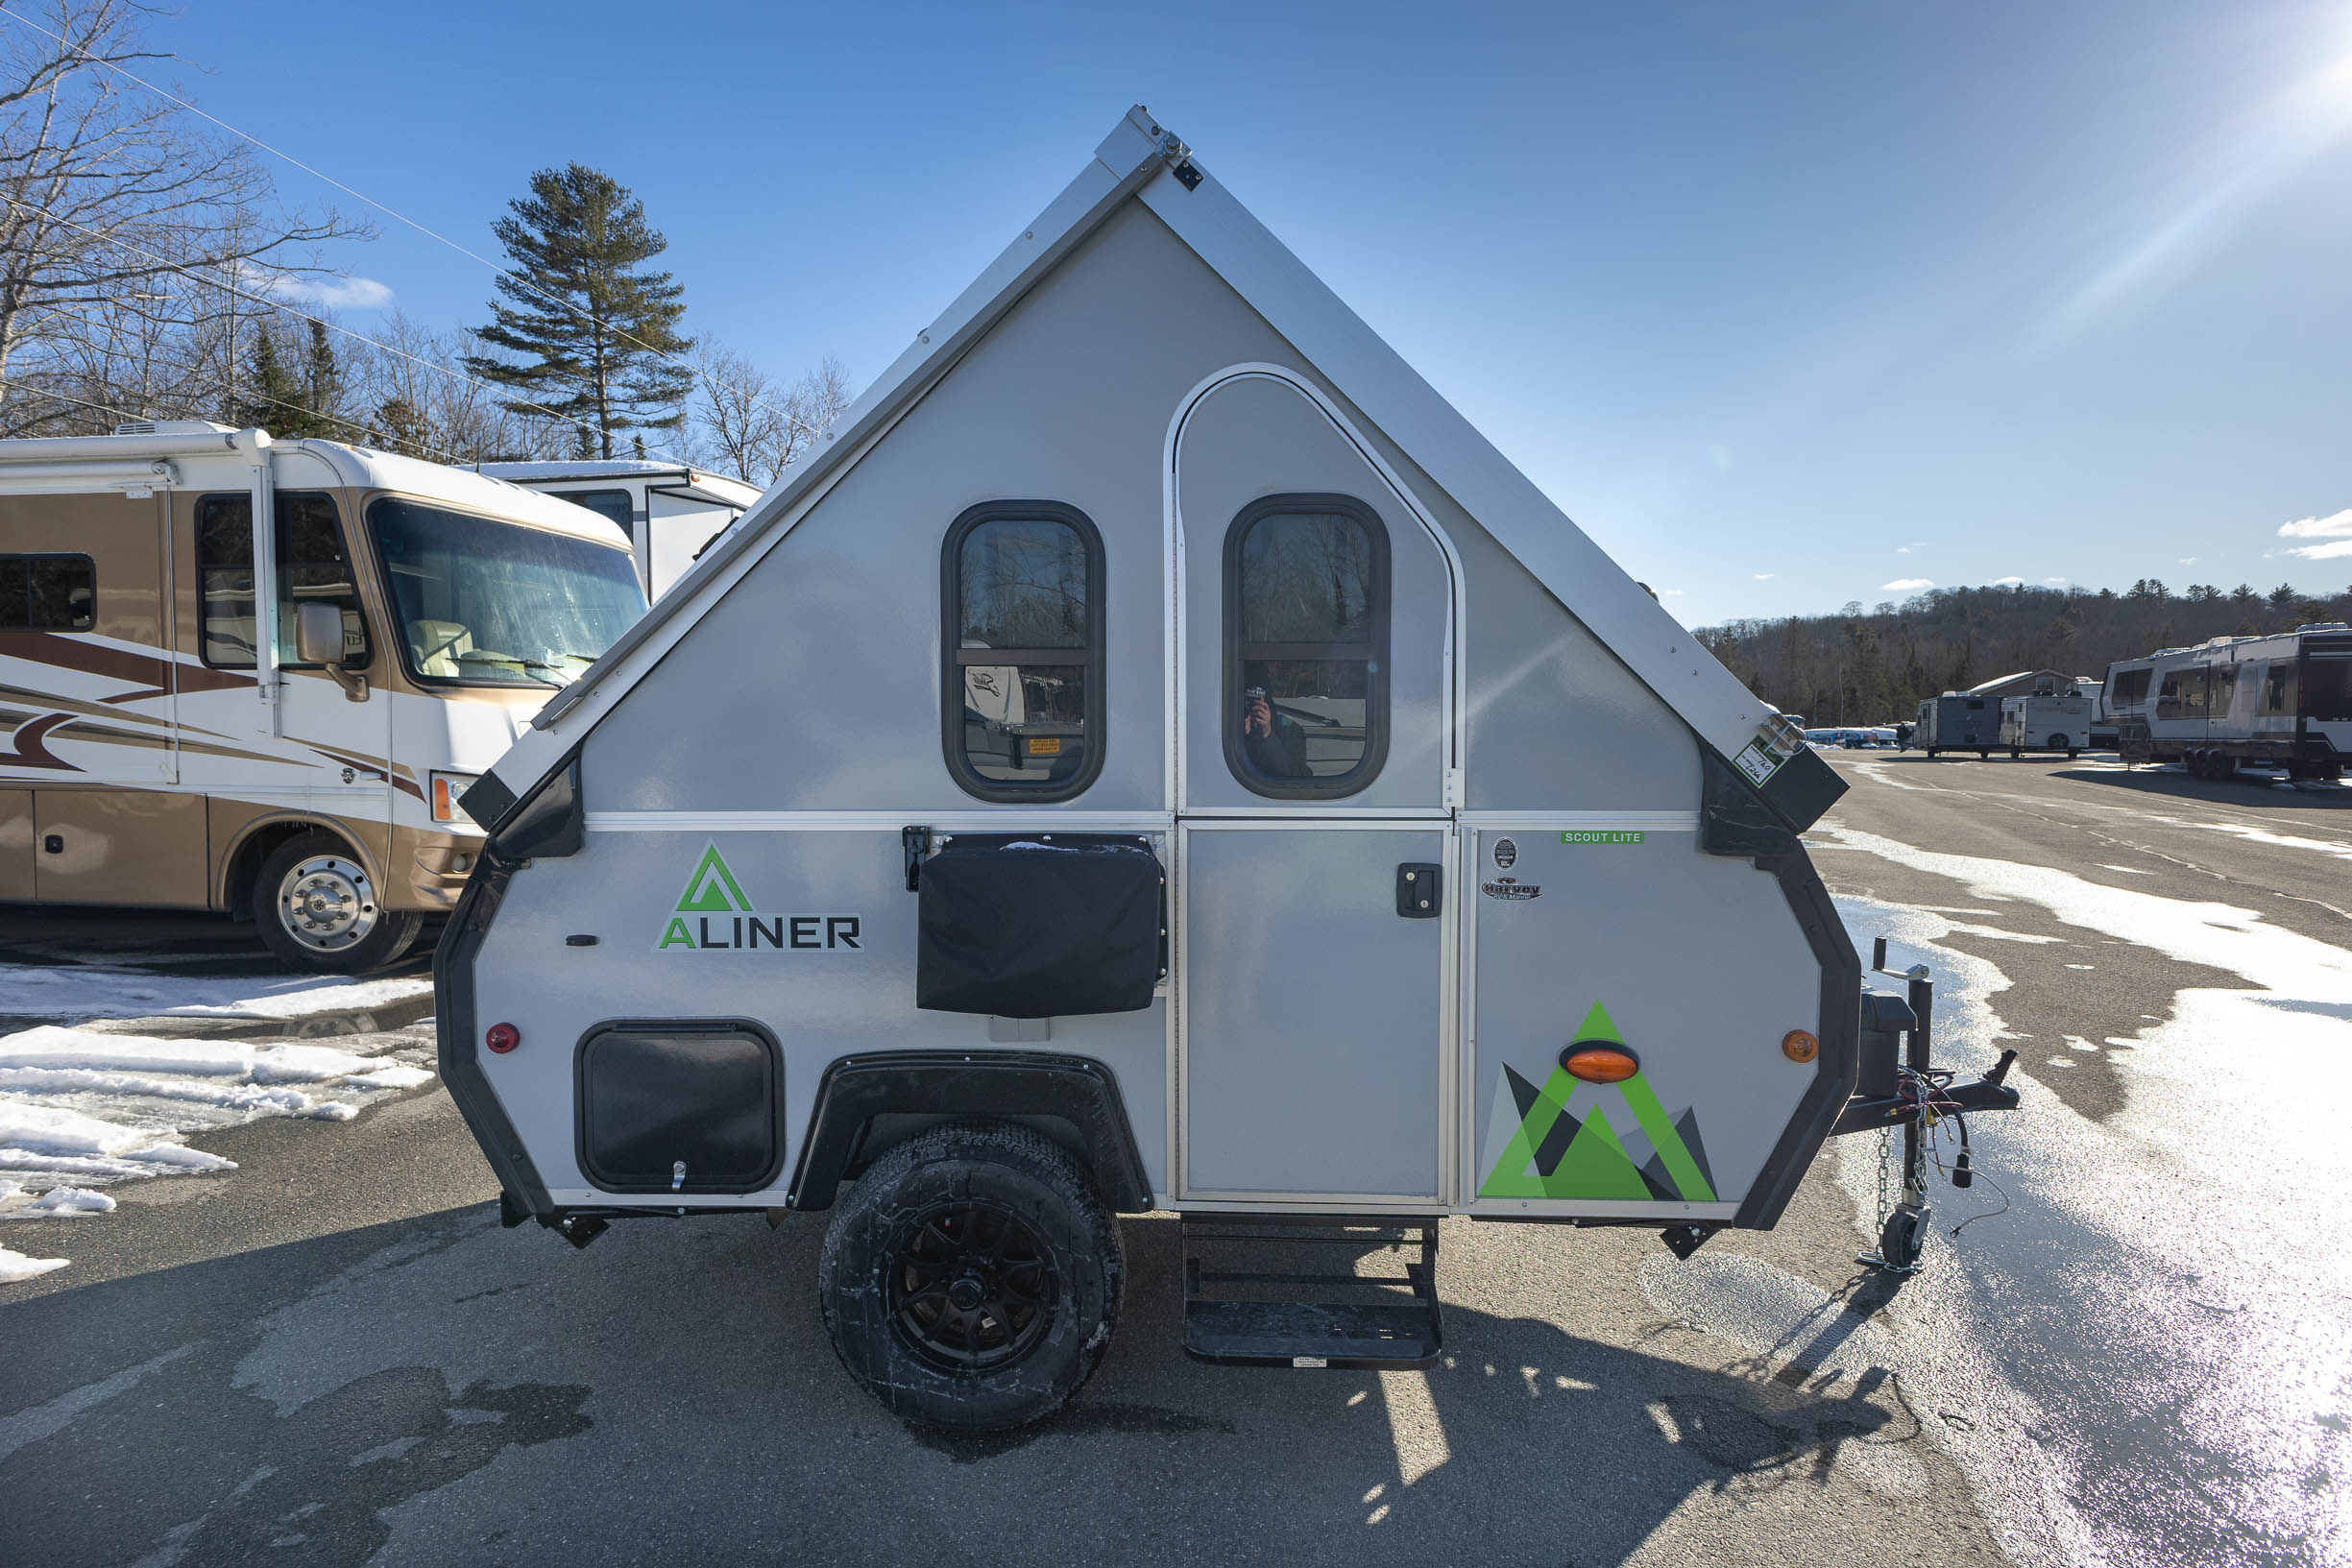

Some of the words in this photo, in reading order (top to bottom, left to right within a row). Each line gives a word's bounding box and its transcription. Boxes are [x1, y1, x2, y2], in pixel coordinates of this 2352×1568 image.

[1565, 832, 1608, 842] SCOUT
[1613, 832, 1640, 842] LITE
[659, 917, 861, 949] ALINER
